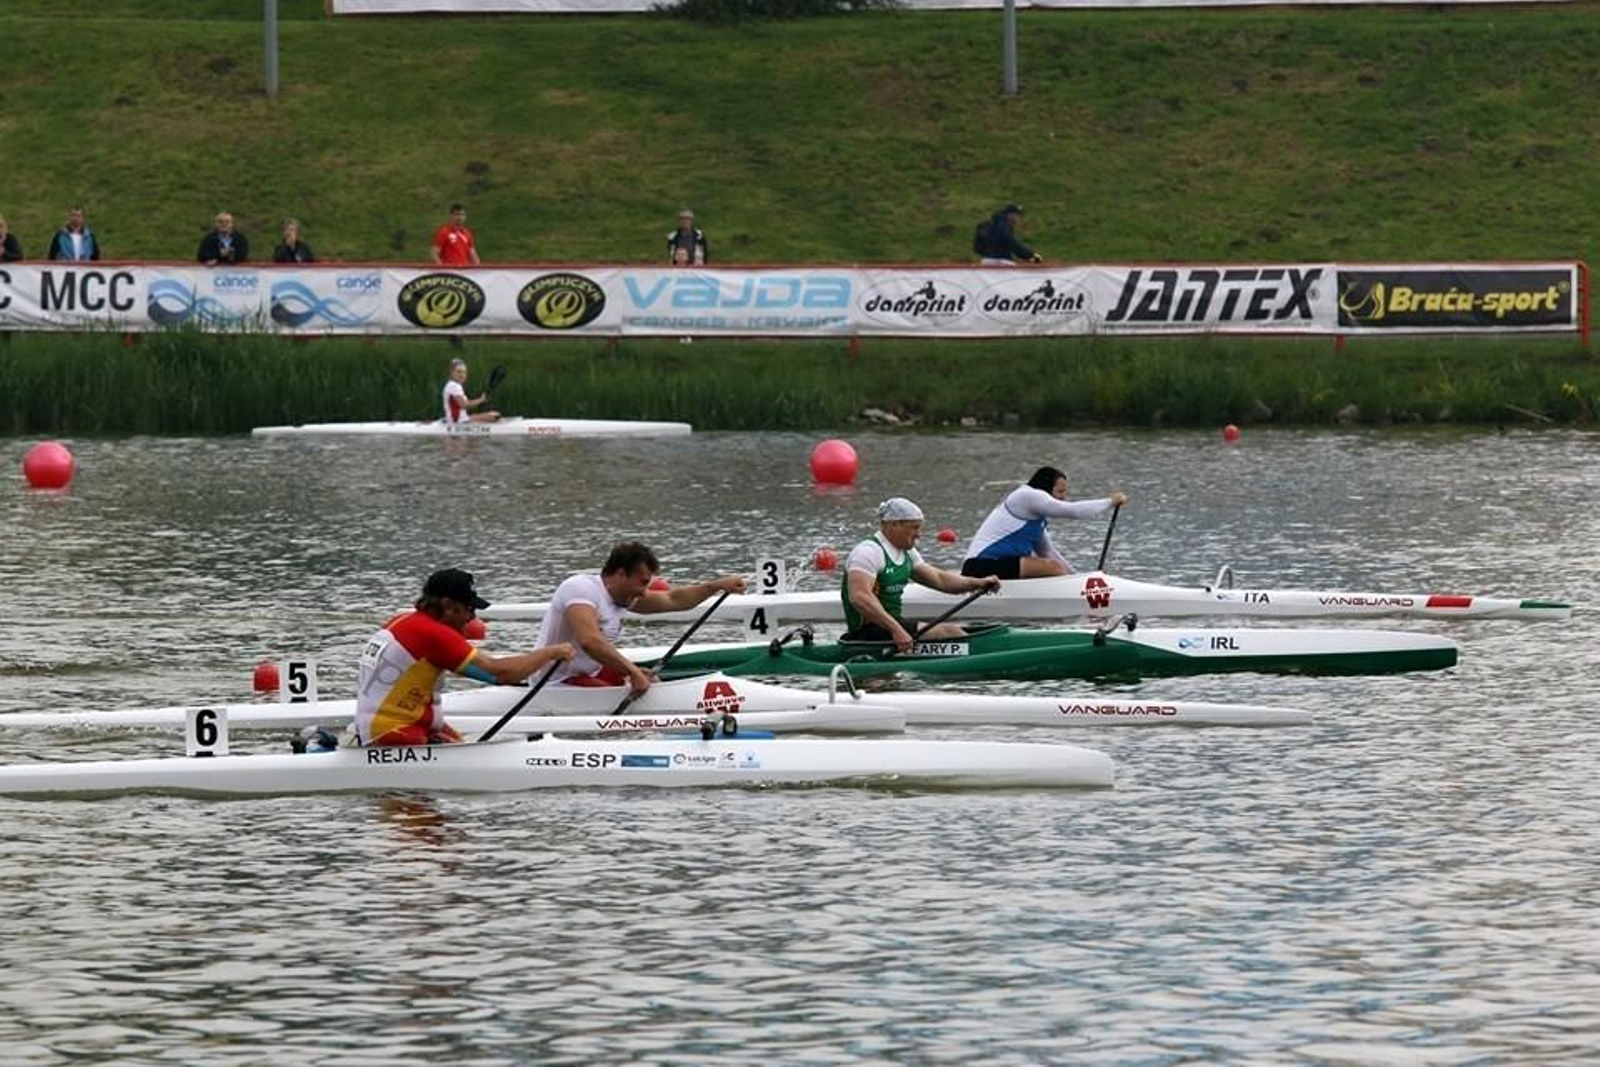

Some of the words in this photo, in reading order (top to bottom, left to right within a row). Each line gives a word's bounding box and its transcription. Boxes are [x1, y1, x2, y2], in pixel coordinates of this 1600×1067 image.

[40, 271, 135, 311] MCC
[1105, 268, 1323, 321] JANTEX
[865, 294, 966, 317] dansprint
[984, 292, 1084, 315] dansprint
[762, 561, 779, 588] 3
[1244, 592, 1271, 604] ITA
[1318, 597, 1414, 607] VANGUARD
[750, 607, 769, 635] 4
[1210, 636, 1240, 651] IRL
[288, 662, 309, 695] 5
[1058, 704, 1178, 716] VANGUARD
[195, 709, 218, 747] 6
[367, 748, 418, 764] REJA
[422, 747, 438, 762] J.
[571, 752, 616, 768] ESP
